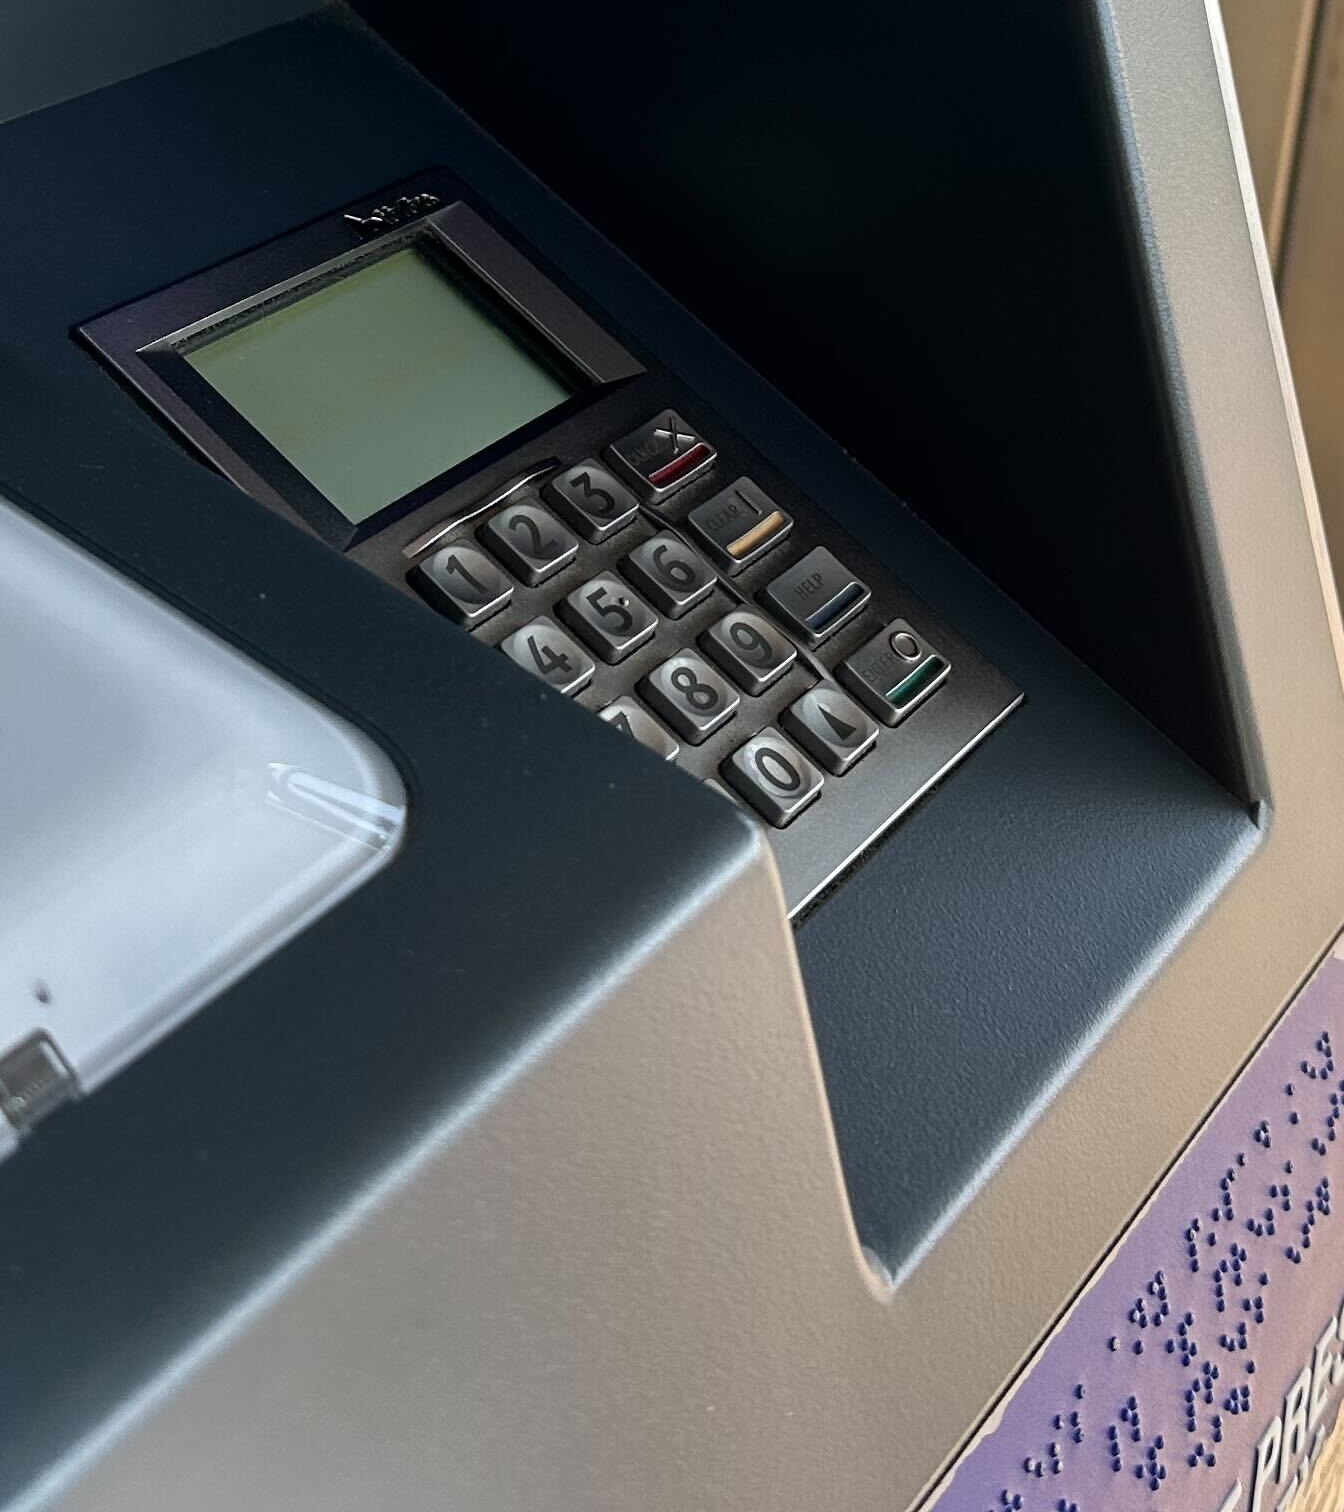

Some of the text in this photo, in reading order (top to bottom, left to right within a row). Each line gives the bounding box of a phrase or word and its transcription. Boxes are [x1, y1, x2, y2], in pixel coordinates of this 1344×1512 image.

[569, 471, 616, 514] 3
[508, 514, 556, 558] 2
[445, 554, 489, 594] 1
[652, 544, 696, 587] 6
[794, 572, 823, 601] HELP
[585, 586, 633, 631] 5
[526, 635, 573, 675] 4
[729, 622, 773, 663] 9
[670, 666, 718, 710] 8
[755, 747, 801, 792] 0
